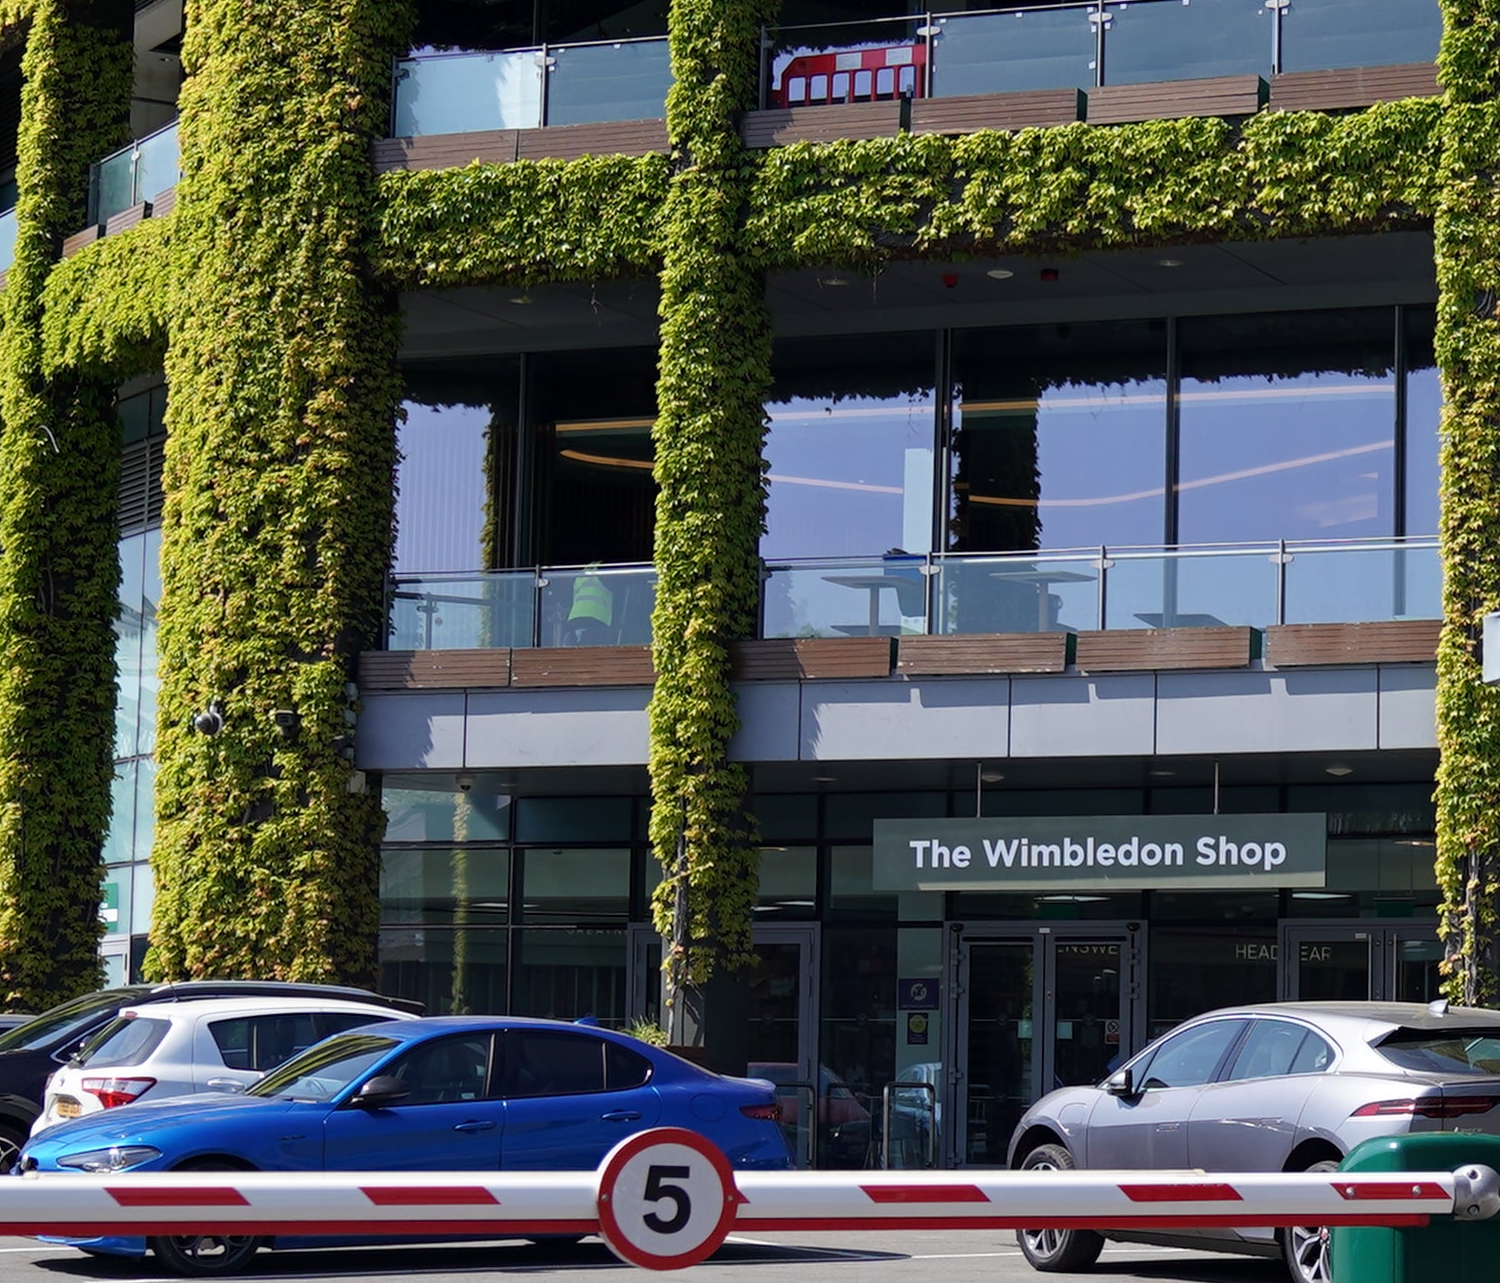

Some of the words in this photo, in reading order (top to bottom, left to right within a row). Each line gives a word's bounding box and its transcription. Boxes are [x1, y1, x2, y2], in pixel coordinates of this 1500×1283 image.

[910, 840, 971, 868] The
[983, 836, 1185, 868] Wimbledon
[1196, 836, 1287, 871] Shop
[1235, 944, 1332, 962] HEADEAR
[642, 1165, 691, 1234] 5
